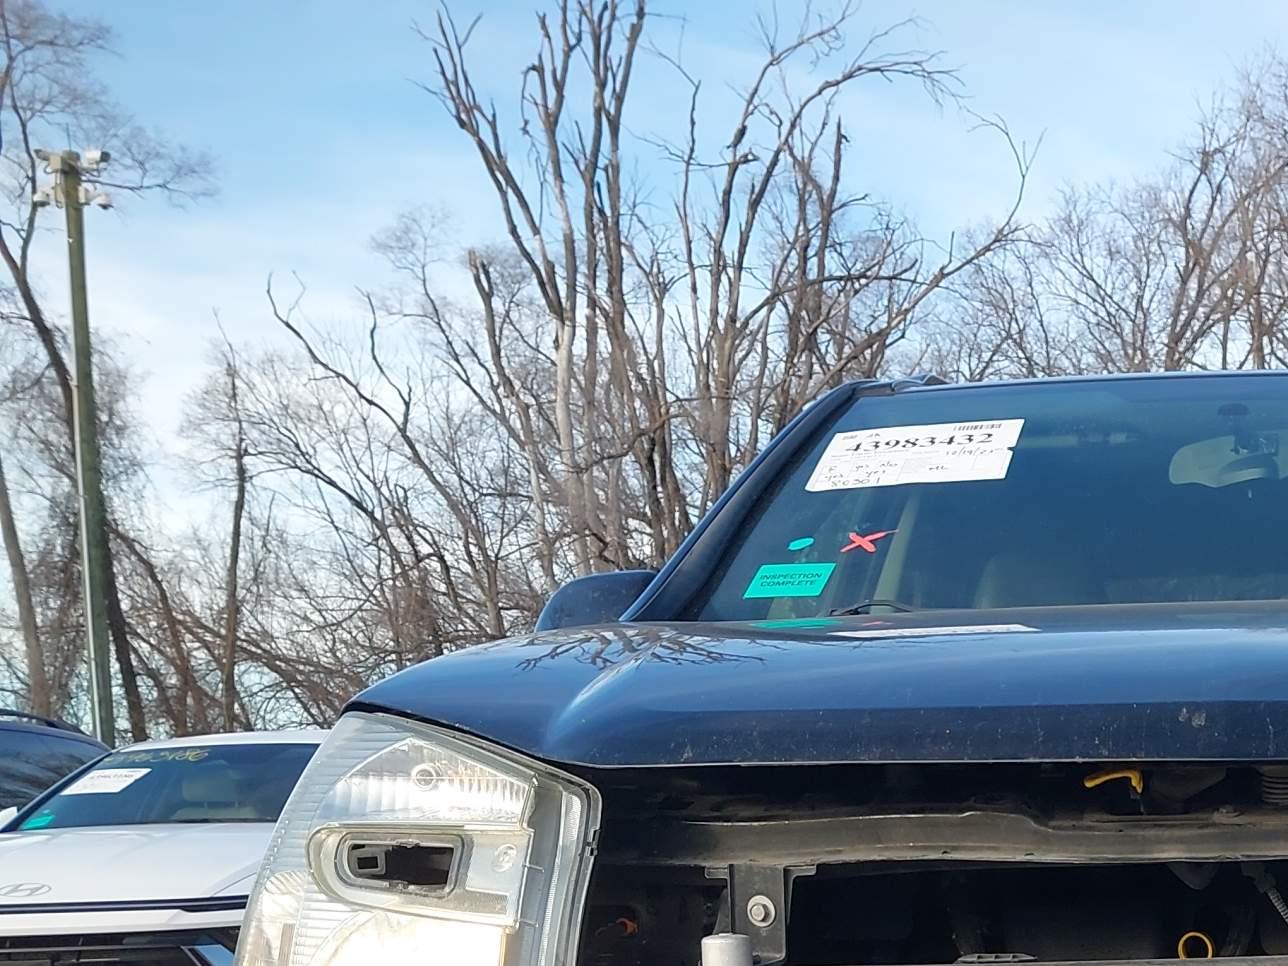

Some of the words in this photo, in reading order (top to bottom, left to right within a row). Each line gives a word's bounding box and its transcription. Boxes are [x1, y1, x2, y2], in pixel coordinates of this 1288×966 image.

[844, 432, 994, 453] 43983432
[760, 572, 823, 580] INSPECTION
[760, 580, 816, 588] COMPLETE
